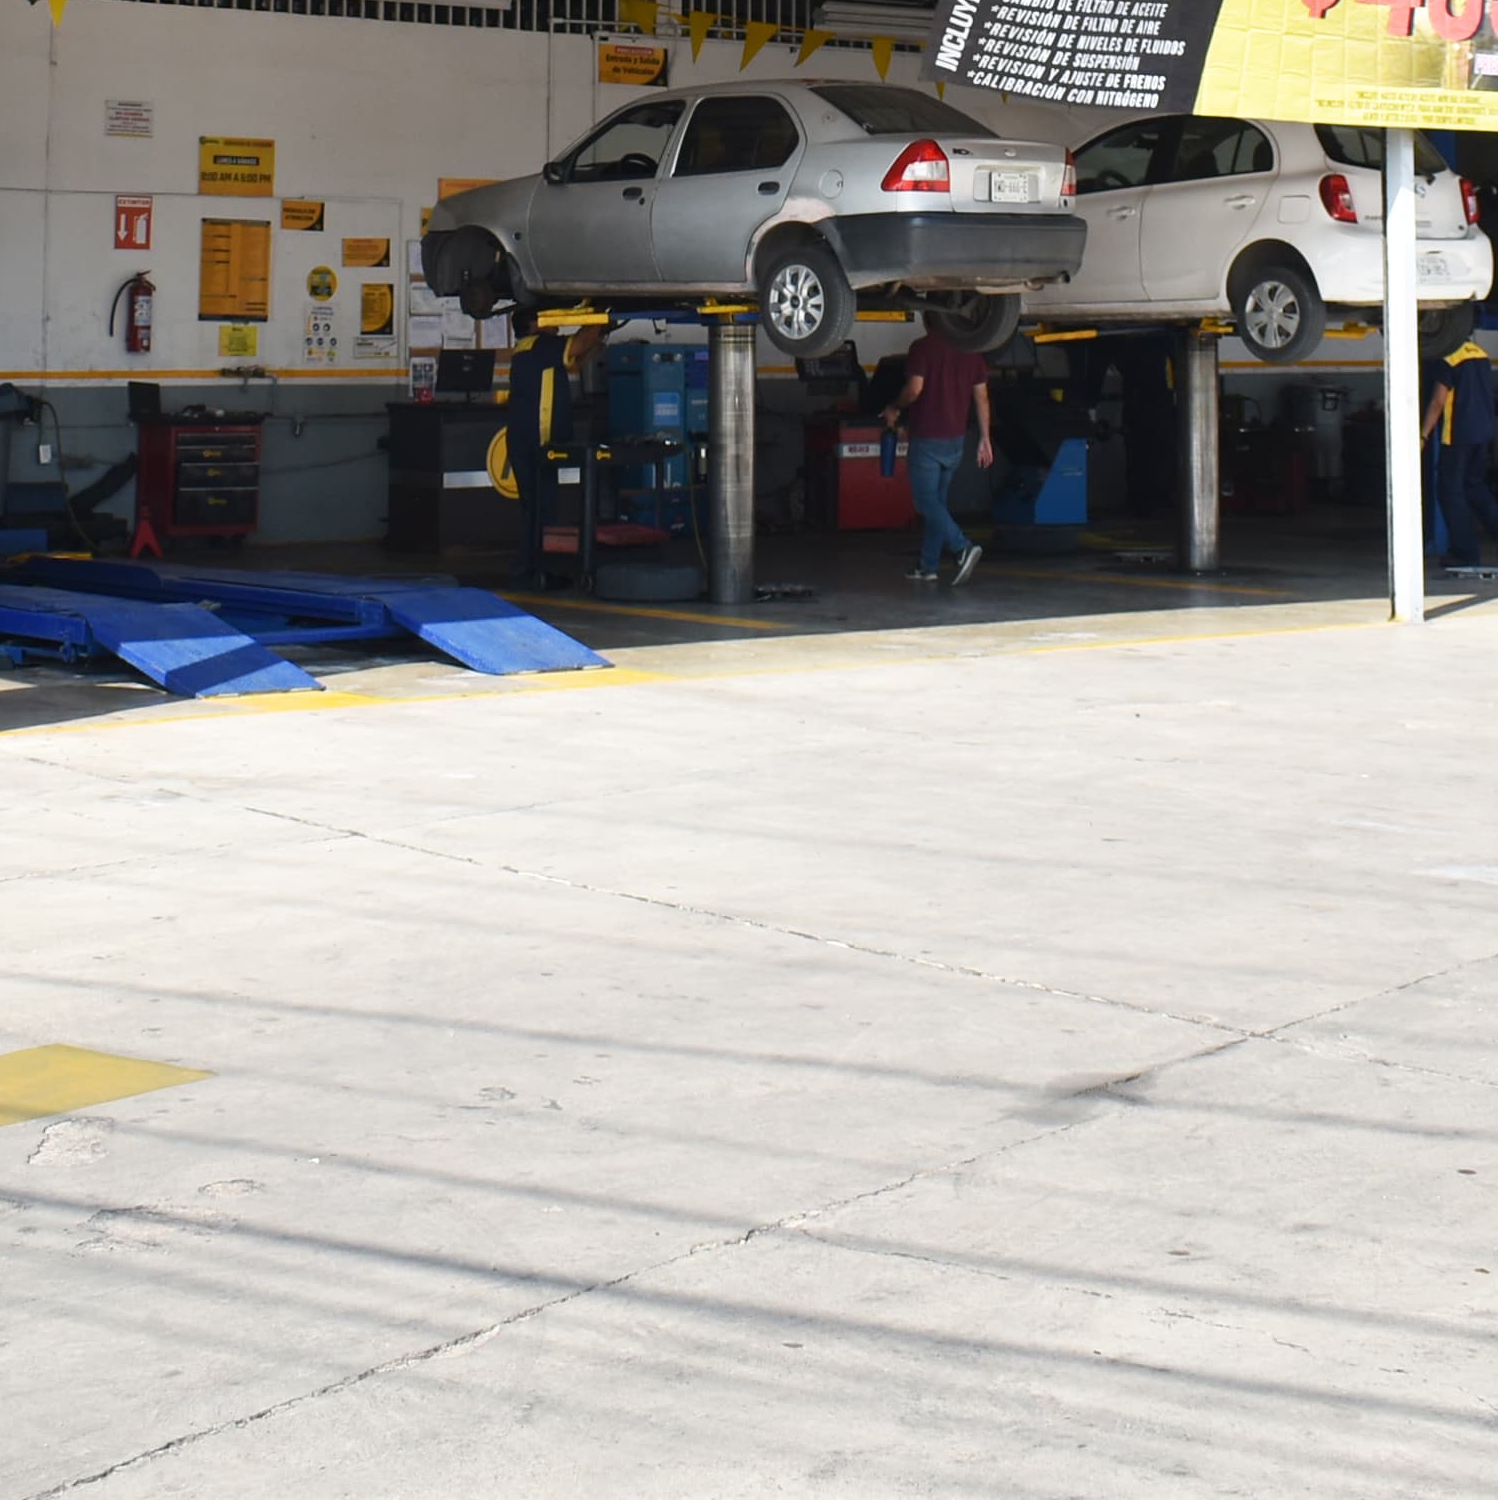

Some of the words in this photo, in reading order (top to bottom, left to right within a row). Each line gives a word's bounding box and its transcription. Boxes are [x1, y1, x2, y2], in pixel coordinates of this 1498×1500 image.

[1115, 0, 1130, 16] DE
[1131, 1, 1168, 18] ACEITE
[1063, 14, 1079, 30] DE
[1082, 16, 1117, 34] FILTRO
[1118, 19, 1134, 35] DE
[1136, 20, 1162, 36] AIRE
[1057, 33, 1074, 49] DE
[1077, 35, 1122, 53] NIVELES
[1124, 37, 1139, 53] DE
[1140, 38, 1186, 56] FLUIDOS
[1052, 50, 1069, 66] DE
[1073, 52, 1141, 71] SUSPENSIÓN
[1048, 67, 1058, 82] Y
[1060, 68, 1103, 87] AJUSTE
[1105, 72, 1121, 88] DE
[1123, 73, 1166, 91] FRENOS
[1067, 88, 1094, 106] CON
[1096, 89, 1159, 109] NITRÓGENO
